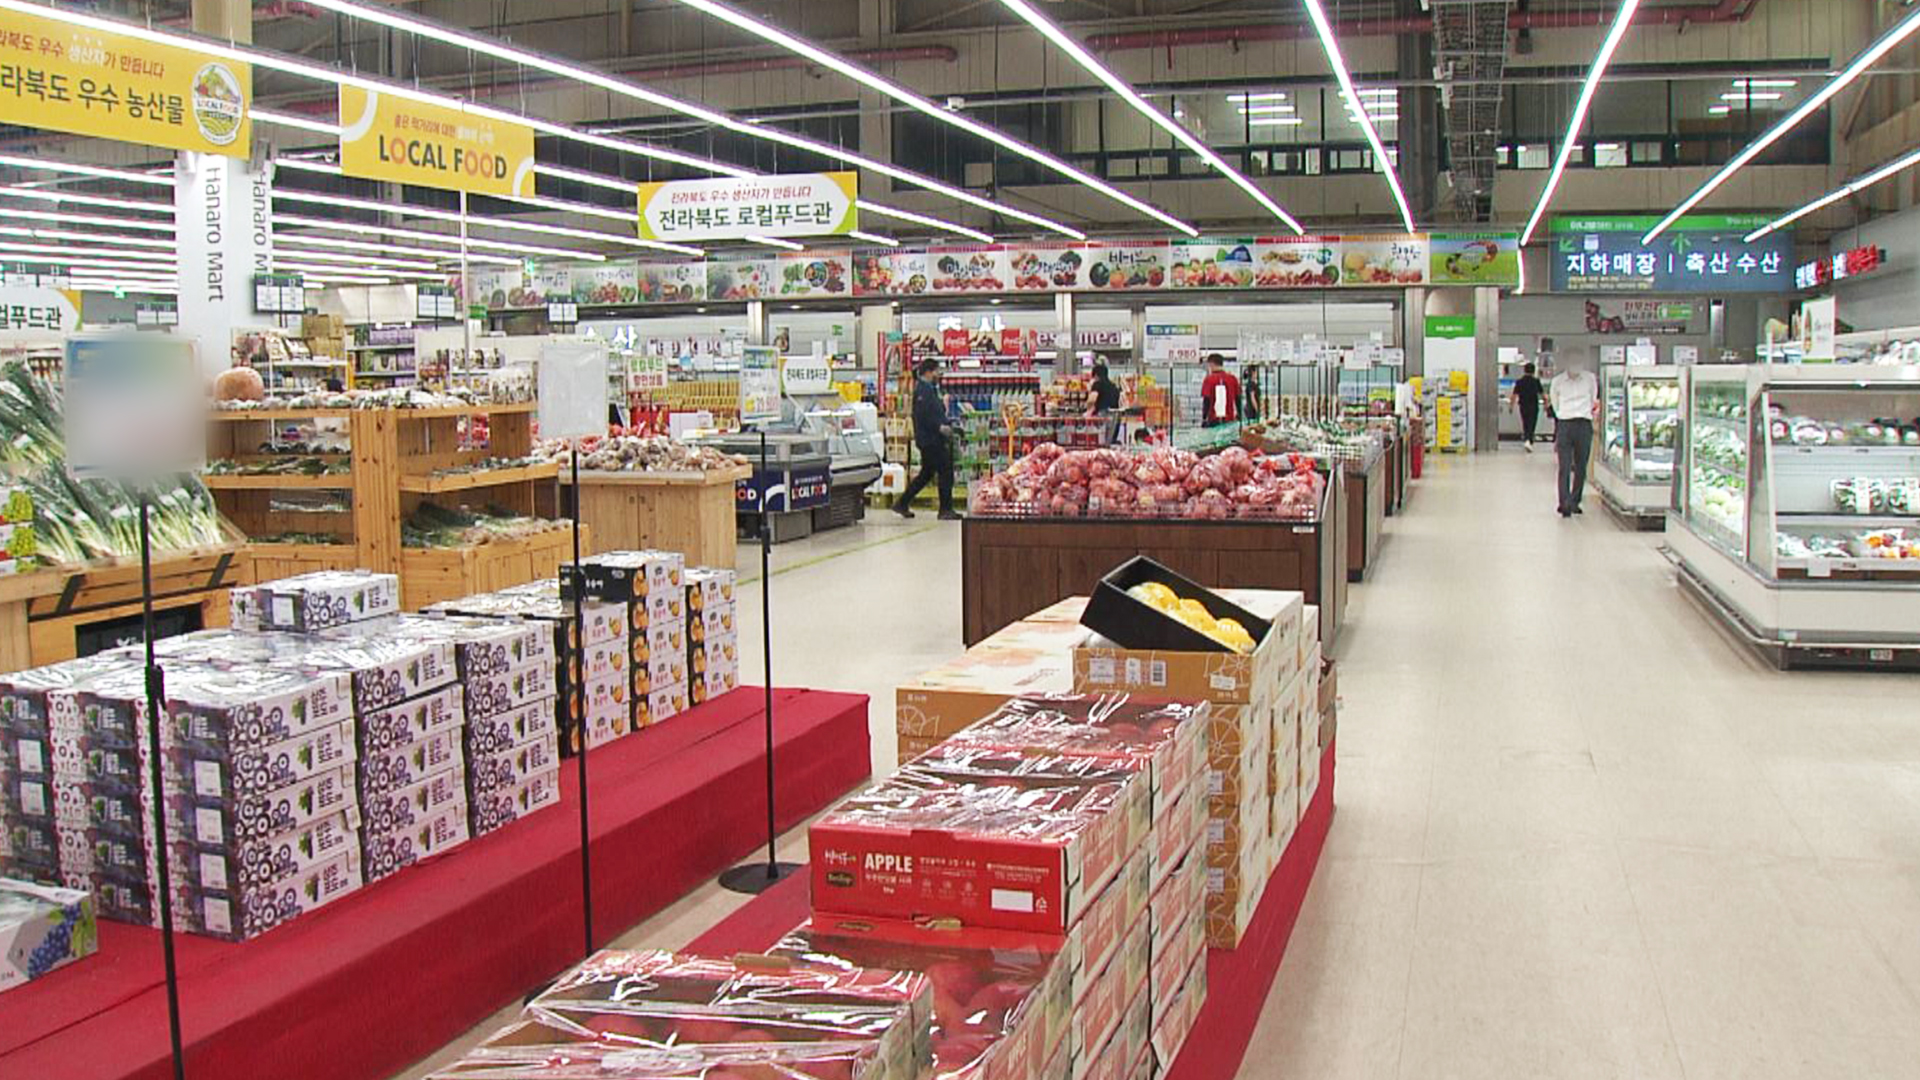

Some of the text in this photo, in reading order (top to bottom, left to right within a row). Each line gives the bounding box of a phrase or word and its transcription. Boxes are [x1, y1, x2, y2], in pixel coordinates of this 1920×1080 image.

[39, 37, 64, 57] 우수
[120, 55, 165, 79] 만듭니다
[78, 78, 120, 114] 우수
[126, 87, 185, 126] 농산물
[379, 134, 447, 170] LOCAL
[454, 148, 507, 179] FOOD
[252, 170, 267, 246] Hanaro
[711, 189, 730, 202] 우수
[773, 185, 812, 200] 만듭니다
[204, 167, 224, 302] Hanaro Mart
[659, 201, 833, 232] 전라북도 로컬푸드관
[1567, 252, 1656, 276] 지하매장
[1685, 252, 1729, 275] 축산
[1736, 251, 1781, 275] 수산
[864, 852, 913, 873] APPLE
